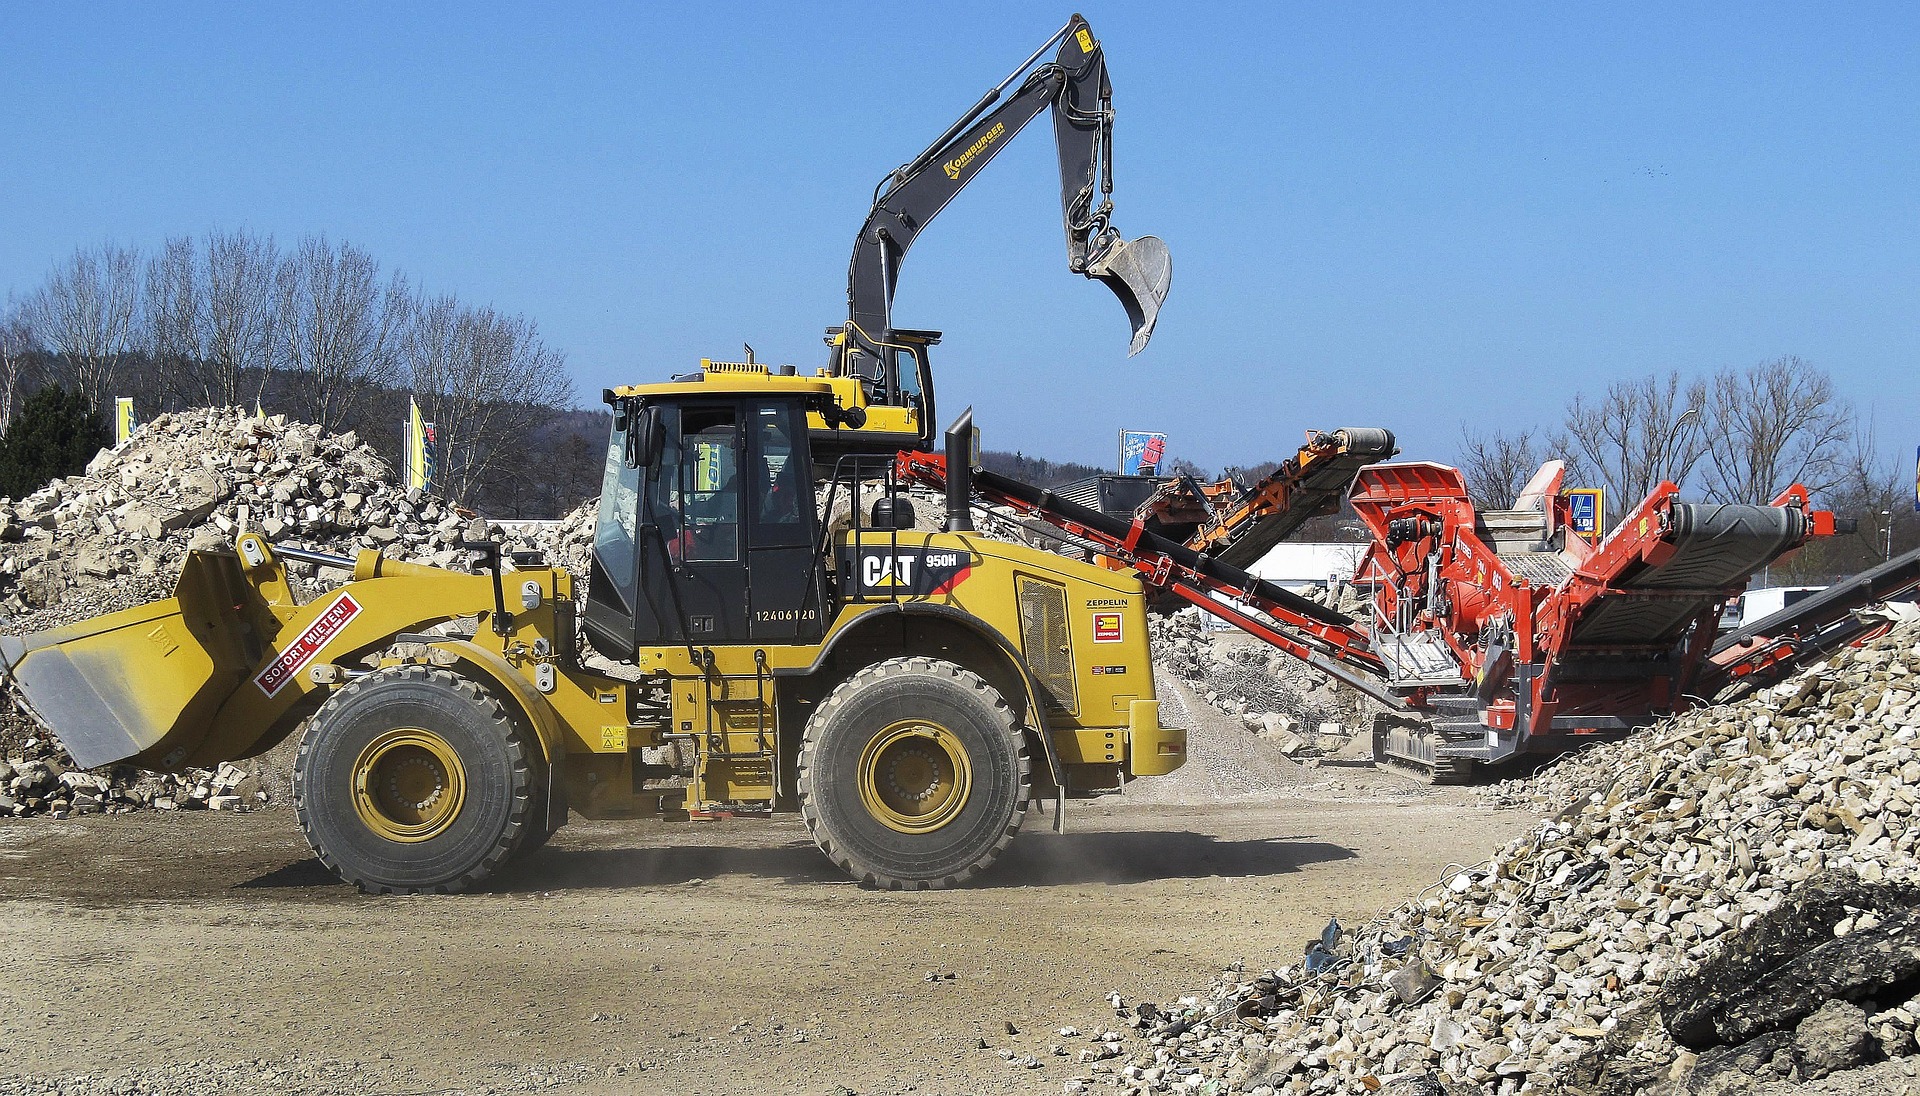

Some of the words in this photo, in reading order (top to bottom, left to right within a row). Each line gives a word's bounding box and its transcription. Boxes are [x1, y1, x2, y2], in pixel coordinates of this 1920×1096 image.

[943, 121, 1004, 178] KORNBURGER
[863, 555, 915, 587] CAT
[926, 554, 957, 568] 950H
[756, 609, 815, 621] 12406120
[264, 643, 305, 684] SOFORT
[304, 602, 348, 646] MIETEN!
